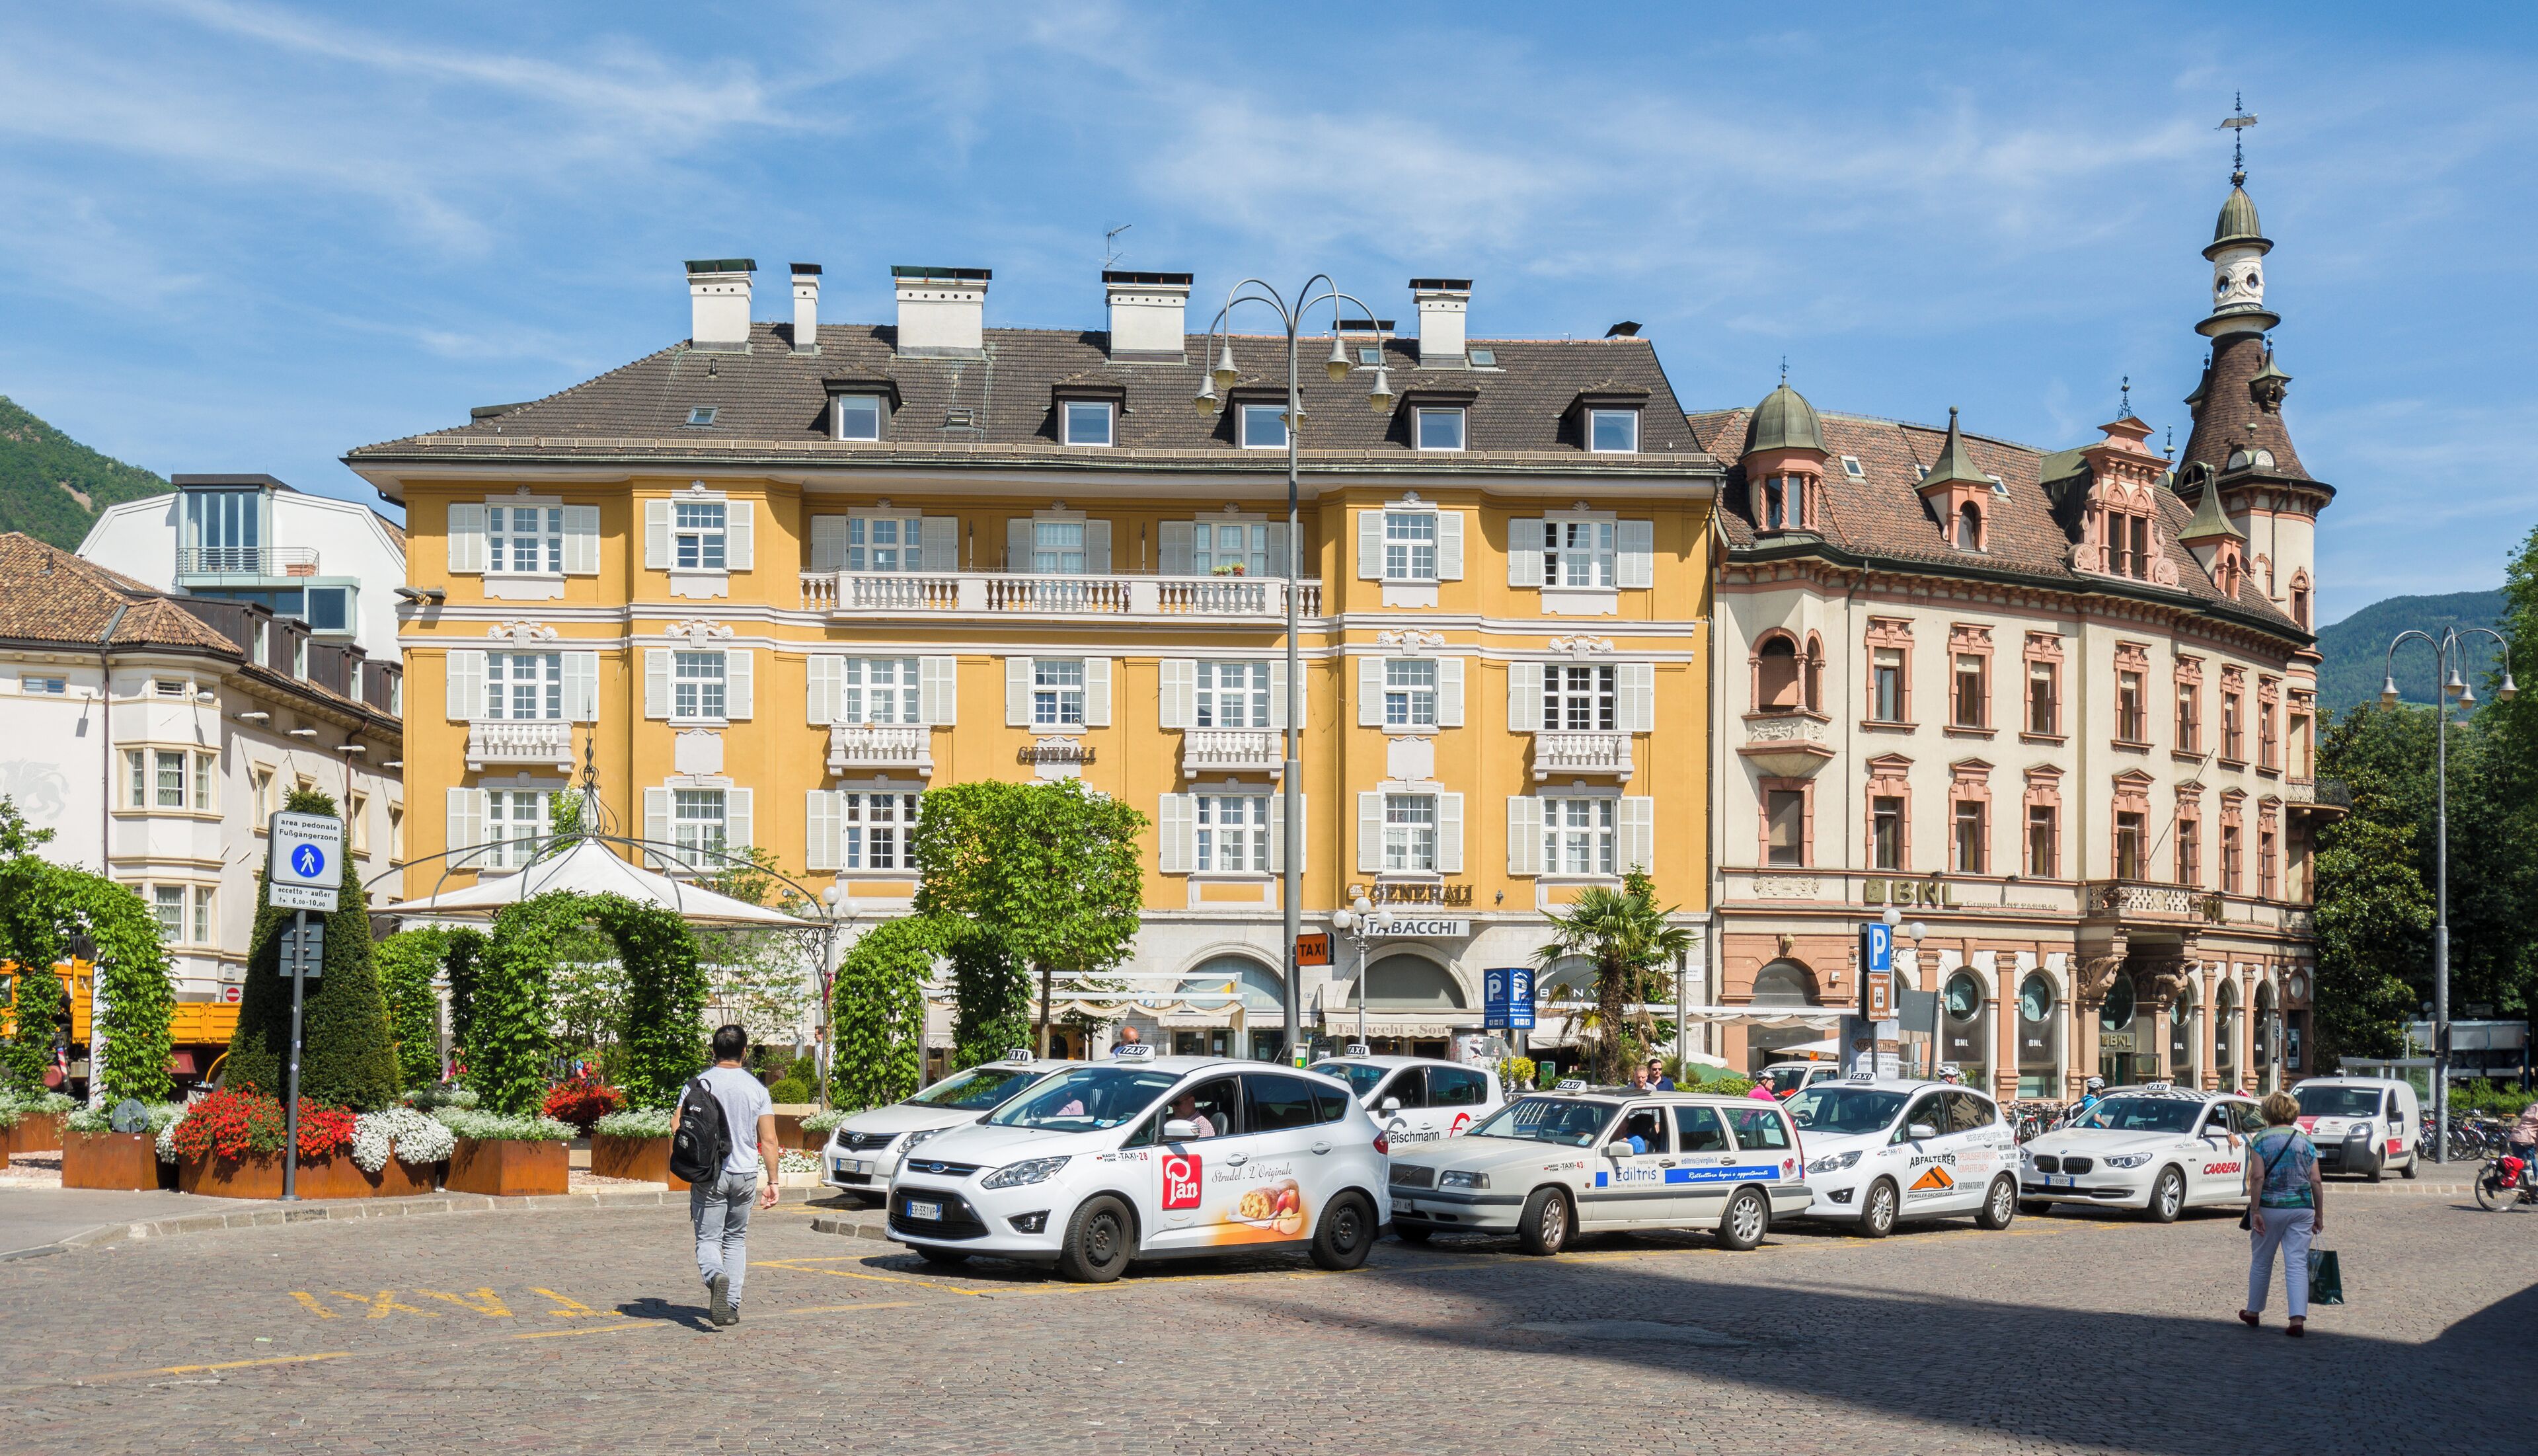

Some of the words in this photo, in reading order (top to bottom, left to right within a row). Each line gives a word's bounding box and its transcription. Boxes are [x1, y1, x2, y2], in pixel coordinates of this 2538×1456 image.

[1019, 746, 1096, 761] GENERALI
[302, 822, 338, 831] pedonale
[279, 829, 338, 841] Fußgängerzone
[1370, 884, 1474, 902] GENERALI
[1892, 880, 1963, 906] BNL
[1966, 900, 1997, 909] Gruppo
[1299, 943, 1325, 957] TAXI
[1872, 929, 1886, 966] P
[2106, 1034, 2132, 1047] BNL
[1008, 1051, 1027, 1061] TAXI
[1123, 1046, 1147, 1055] TAXI
[1347, 1046, 1365, 1055] TAXI
[1909, 1155, 1956, 1169] ABFALTERER
[2203, 1162, 2241, 1174] CARRERA
[1615, 1166, 1656, 1182] Ediltris
[1165, 1158, 1198, 1206] Pan
[1958, 1181, 1985, 1190] REPARATUREN
